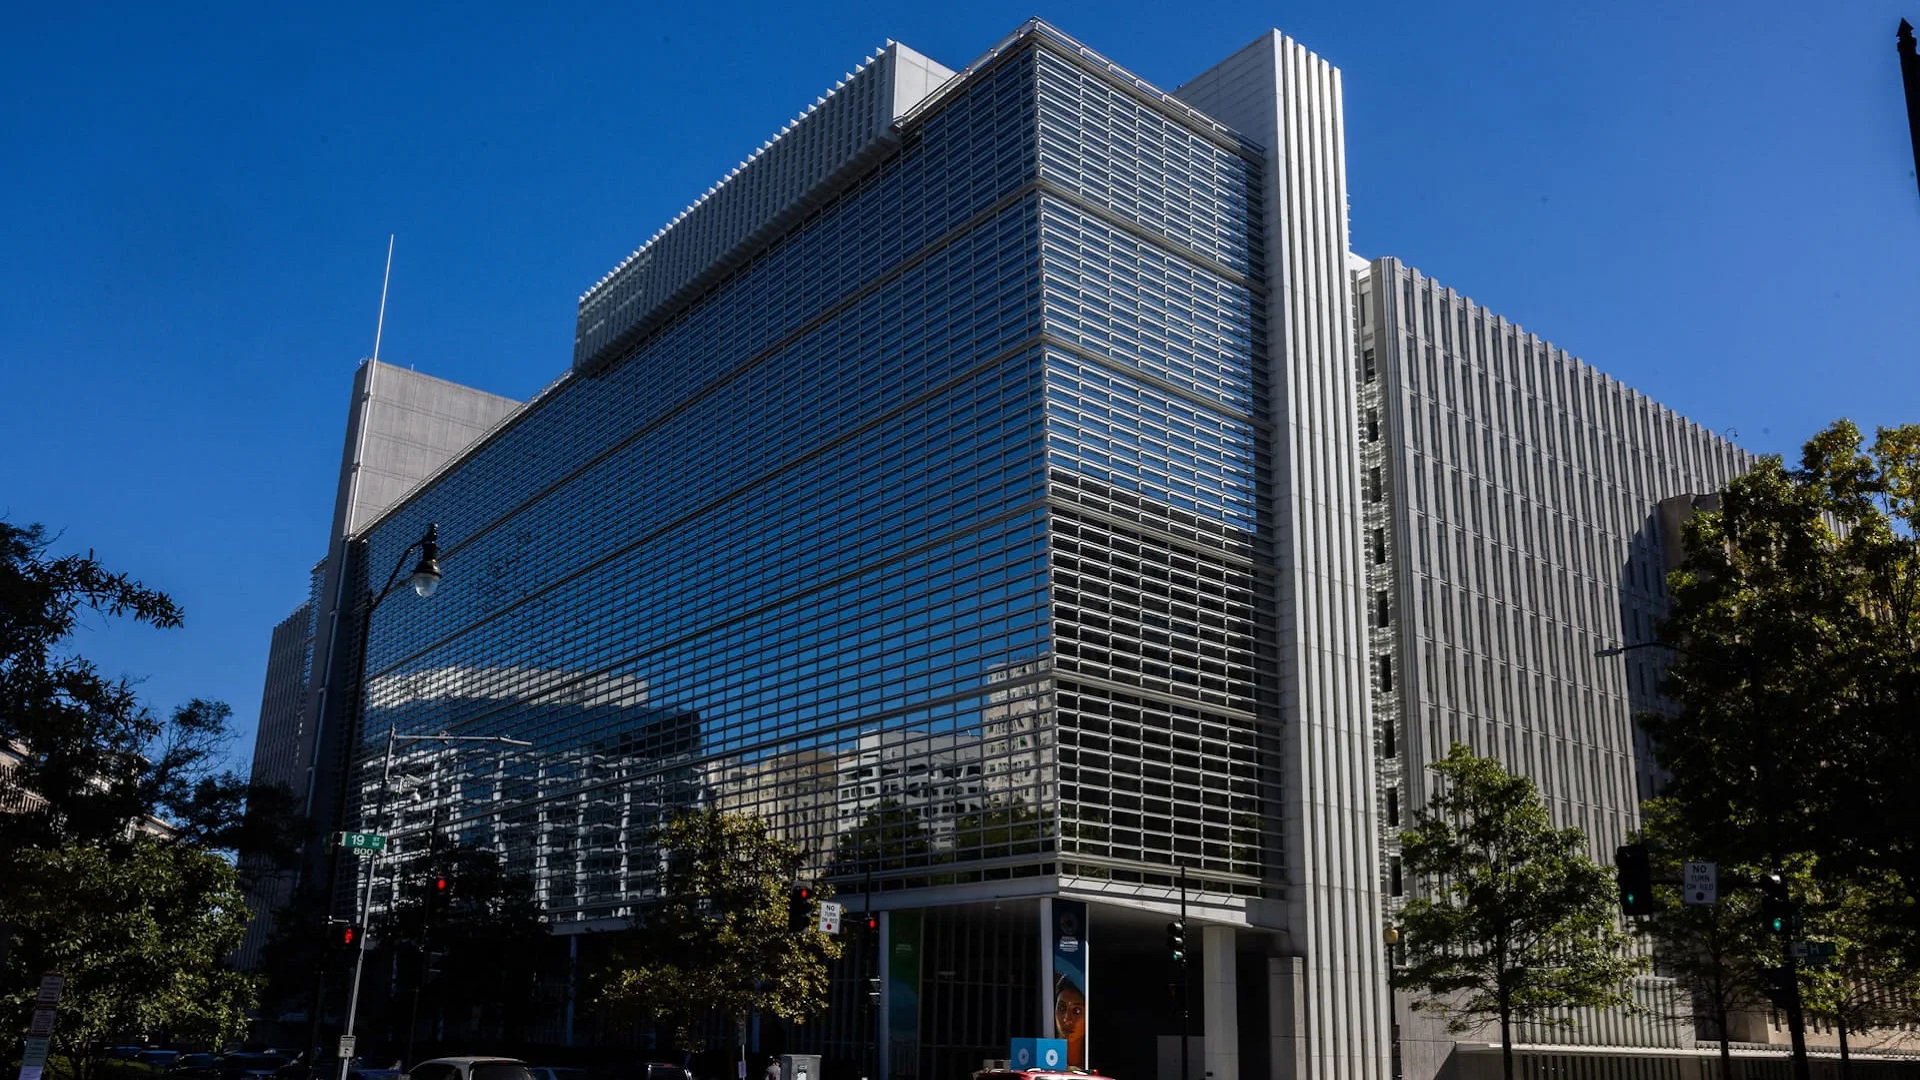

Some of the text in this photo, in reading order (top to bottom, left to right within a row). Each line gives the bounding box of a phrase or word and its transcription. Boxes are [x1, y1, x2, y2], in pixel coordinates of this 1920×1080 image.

[351, 834, 365, 846] 19
[353, 847, 374, 856] 800
[1692, 864, 1707, 874] NO
[1691, 874, 1710, 883] TURN
[1699, 883, 1714, 891] RED
[826, 904, 835, 912] NO
